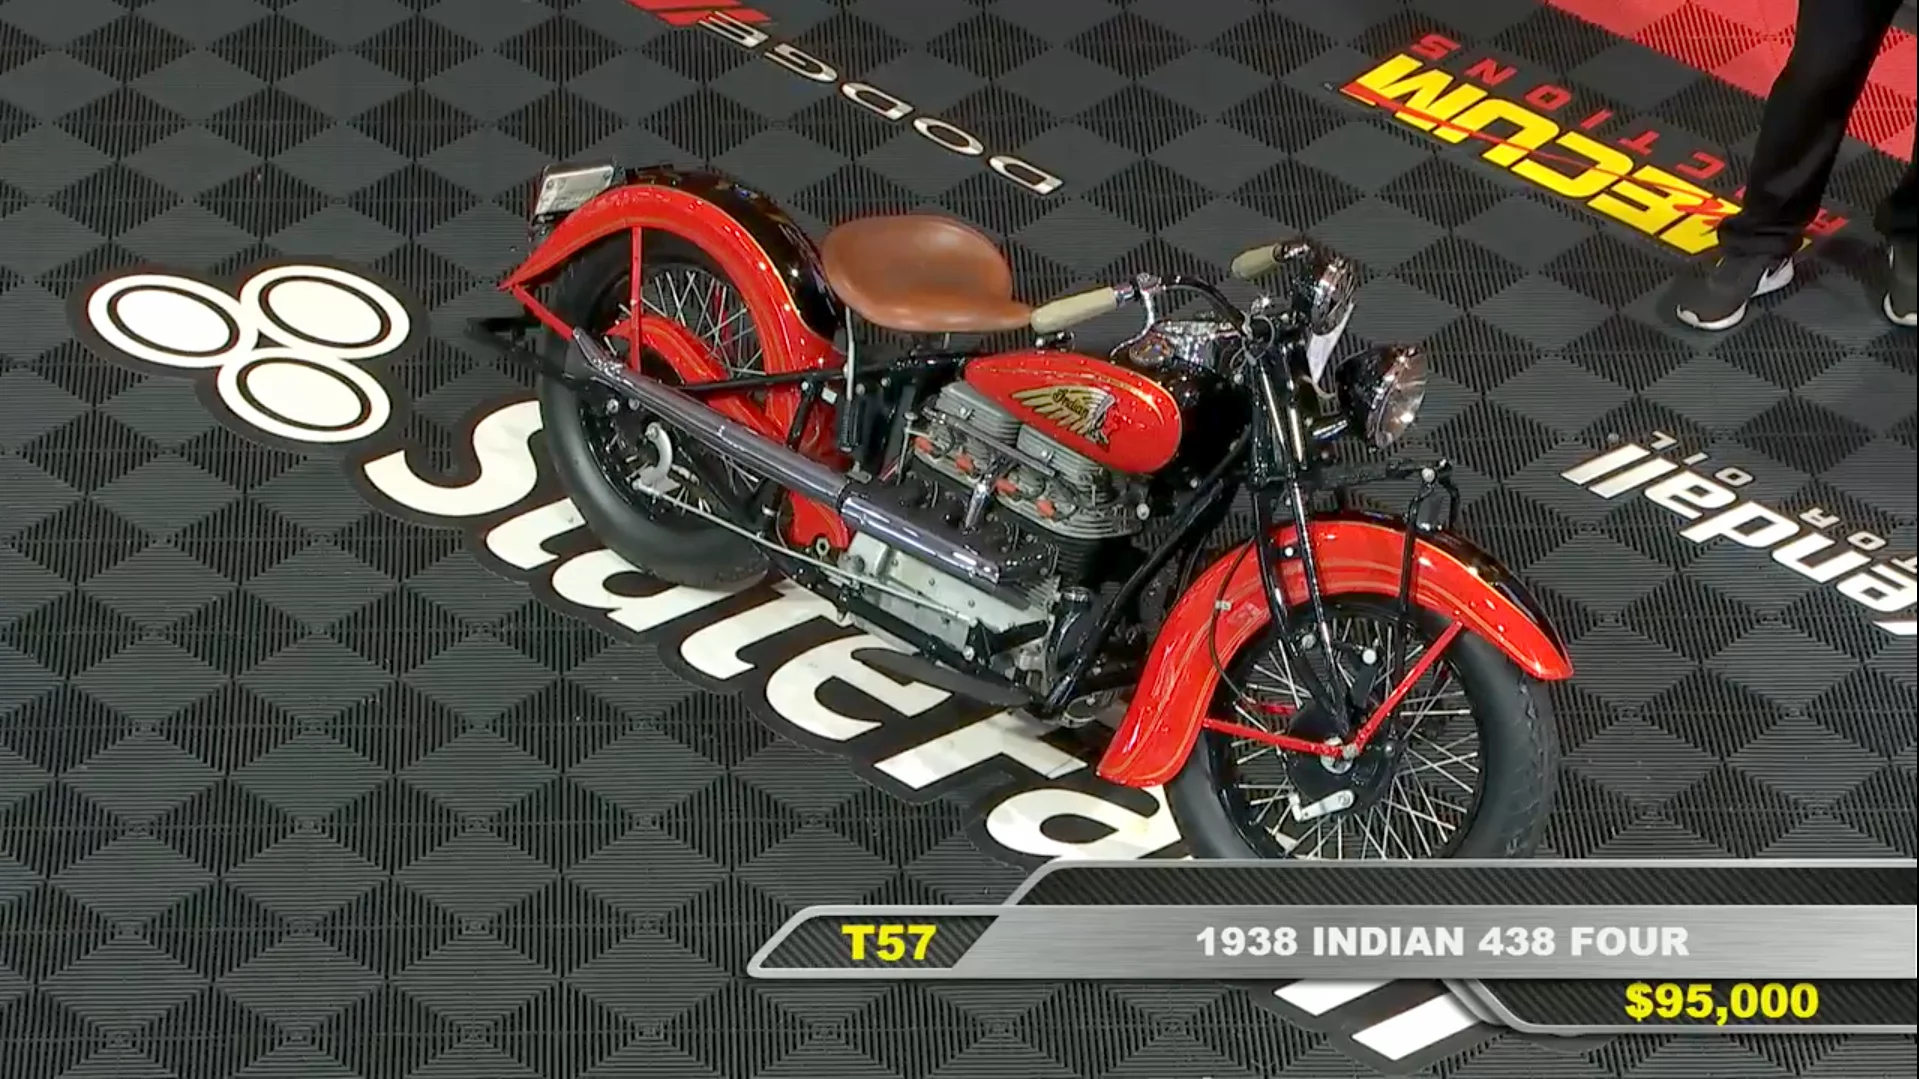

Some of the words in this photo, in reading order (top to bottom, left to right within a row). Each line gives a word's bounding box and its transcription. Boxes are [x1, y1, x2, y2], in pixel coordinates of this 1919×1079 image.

[698, 10, 1064, 196] DODGE
[1410, 33, 1850, 236] ACTIONS
[1052, 388, 1090, 419] Indian
[1650, 430, 1755, 487] OIL
[1560, 443, 1918, 635] endall
